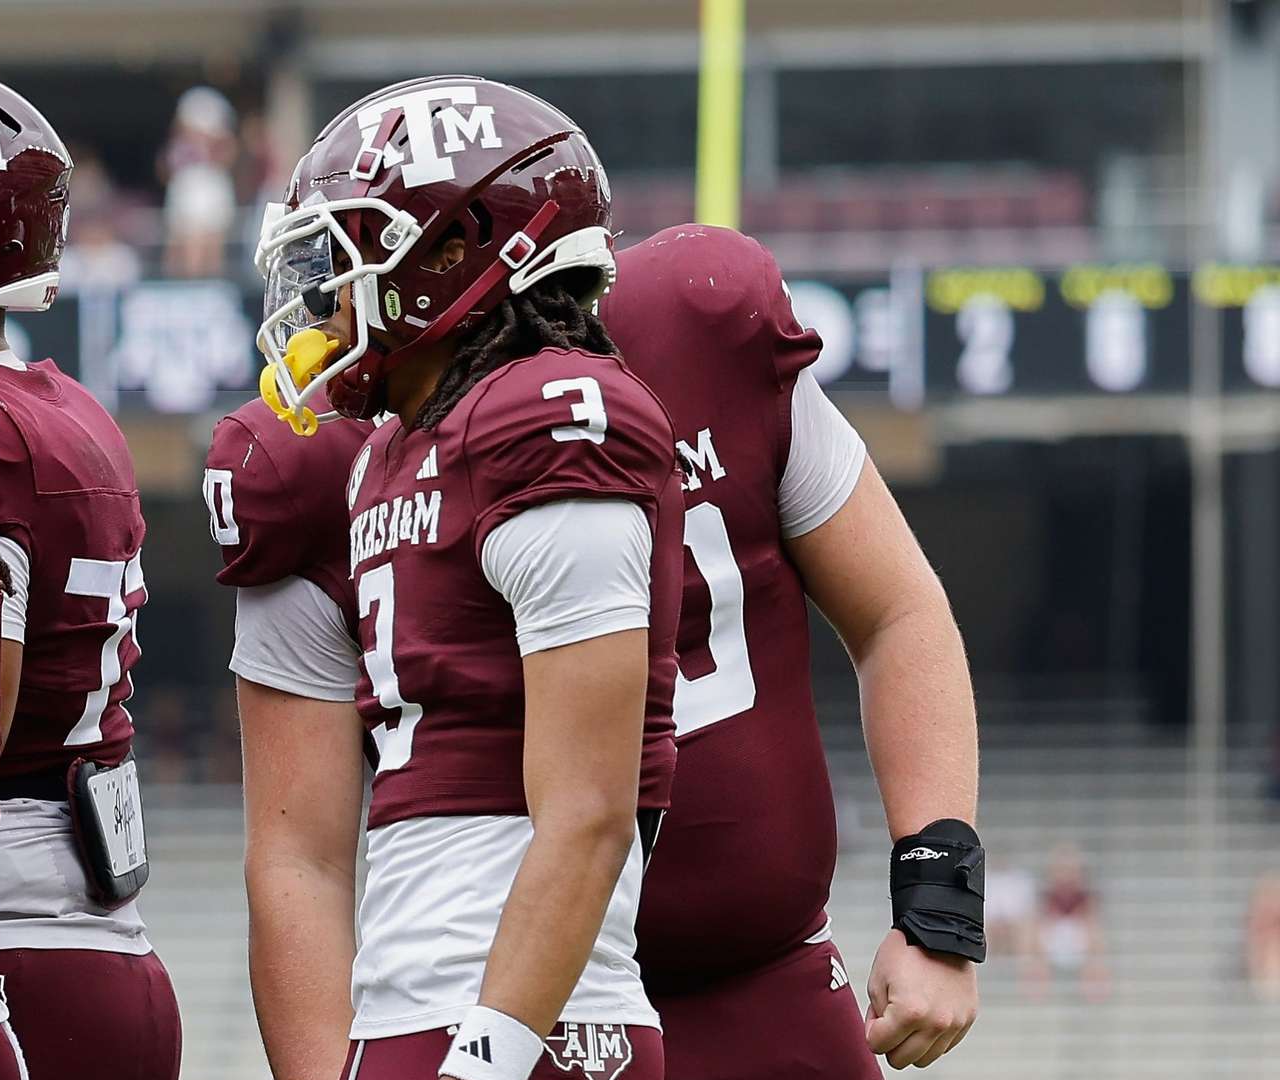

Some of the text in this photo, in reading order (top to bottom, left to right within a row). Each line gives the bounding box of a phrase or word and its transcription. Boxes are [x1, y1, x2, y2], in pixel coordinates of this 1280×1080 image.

[542, 376, 607, 444] 3
[386, 490, 442, 550] A&M
[358, 562, 424, 772] 3
